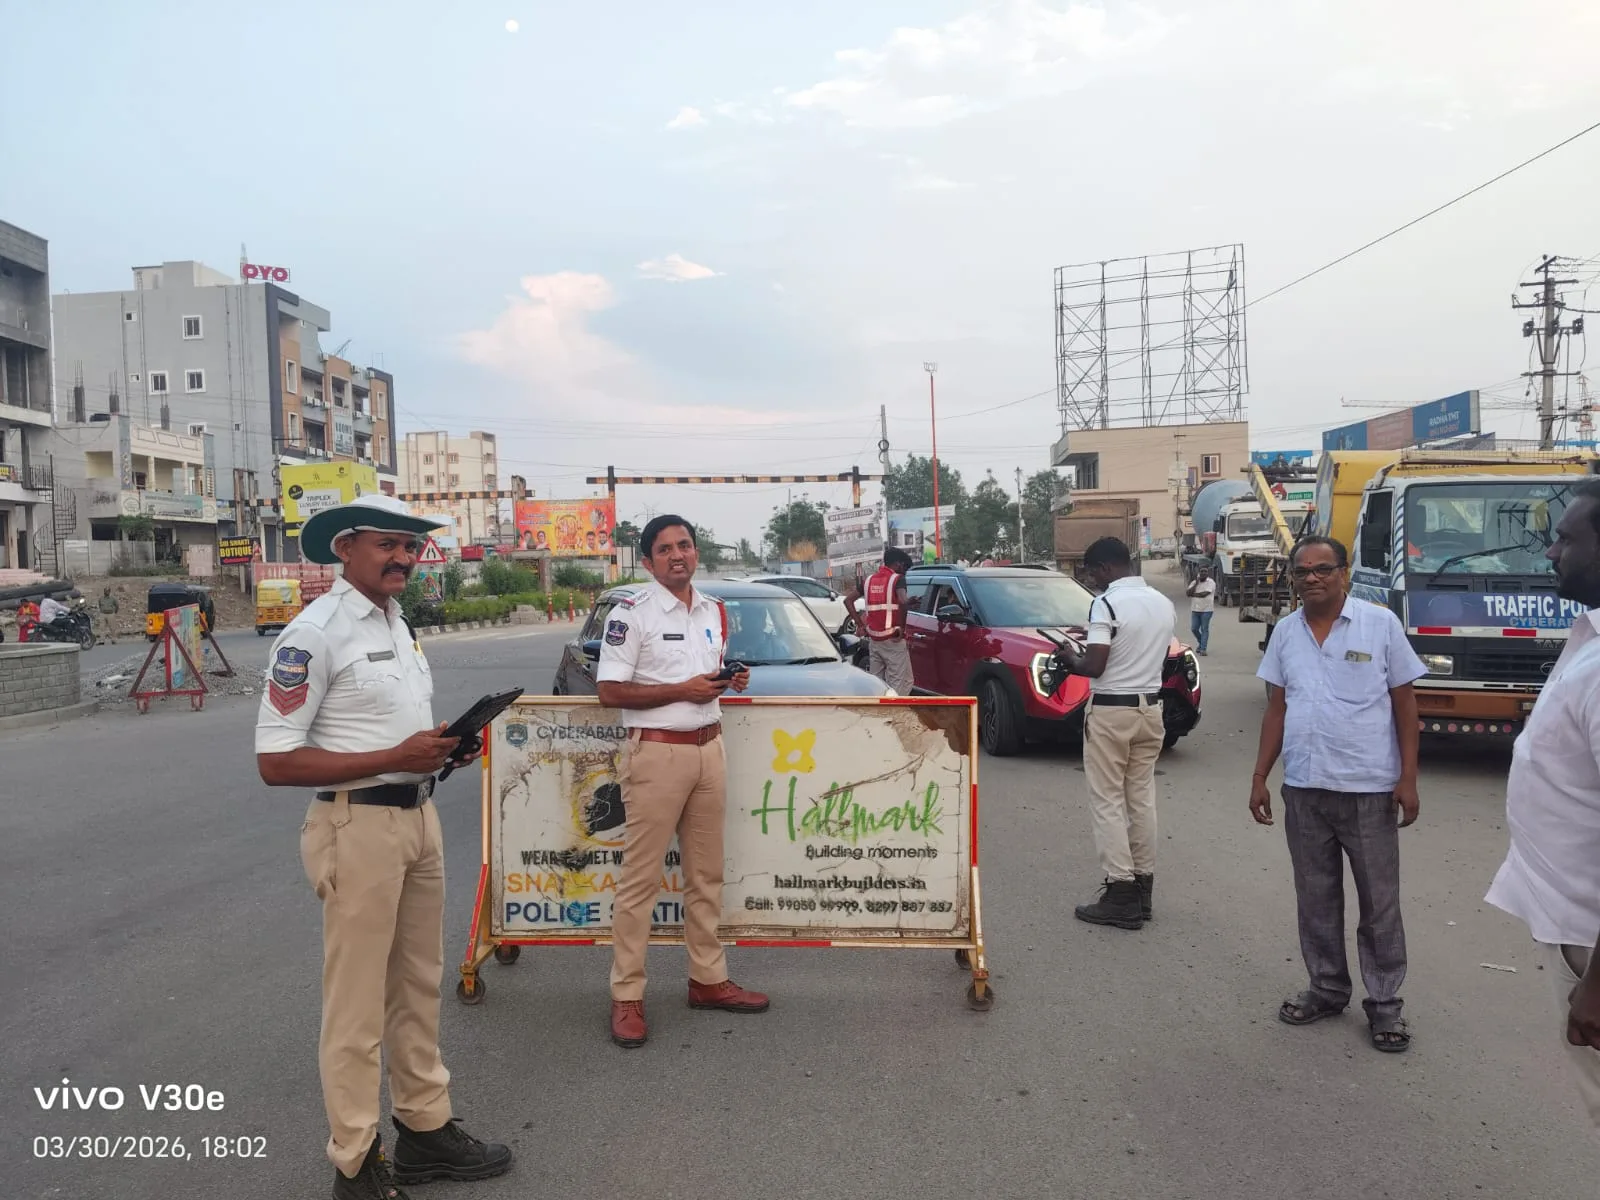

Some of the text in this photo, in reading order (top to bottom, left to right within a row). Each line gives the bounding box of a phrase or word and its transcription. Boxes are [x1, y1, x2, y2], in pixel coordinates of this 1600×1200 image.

[243, 264, 288, 282] OYO
[219, 546, 253, 557] BOTIQUE
[1483, 596, 1555, 617] TRAFFIC
[537, 726, 628, 740] CYBERABAD
[751, 776, 944, 843] Hallmark
[522, 851, 558, 865] WEAR
[806, 845, 938, 860] Building moments
[775, 875, 928, 890] hallmarkbuilders.in
[744, 896, 774, 911] Call:
[506, 901, 601, 923] POLICE
